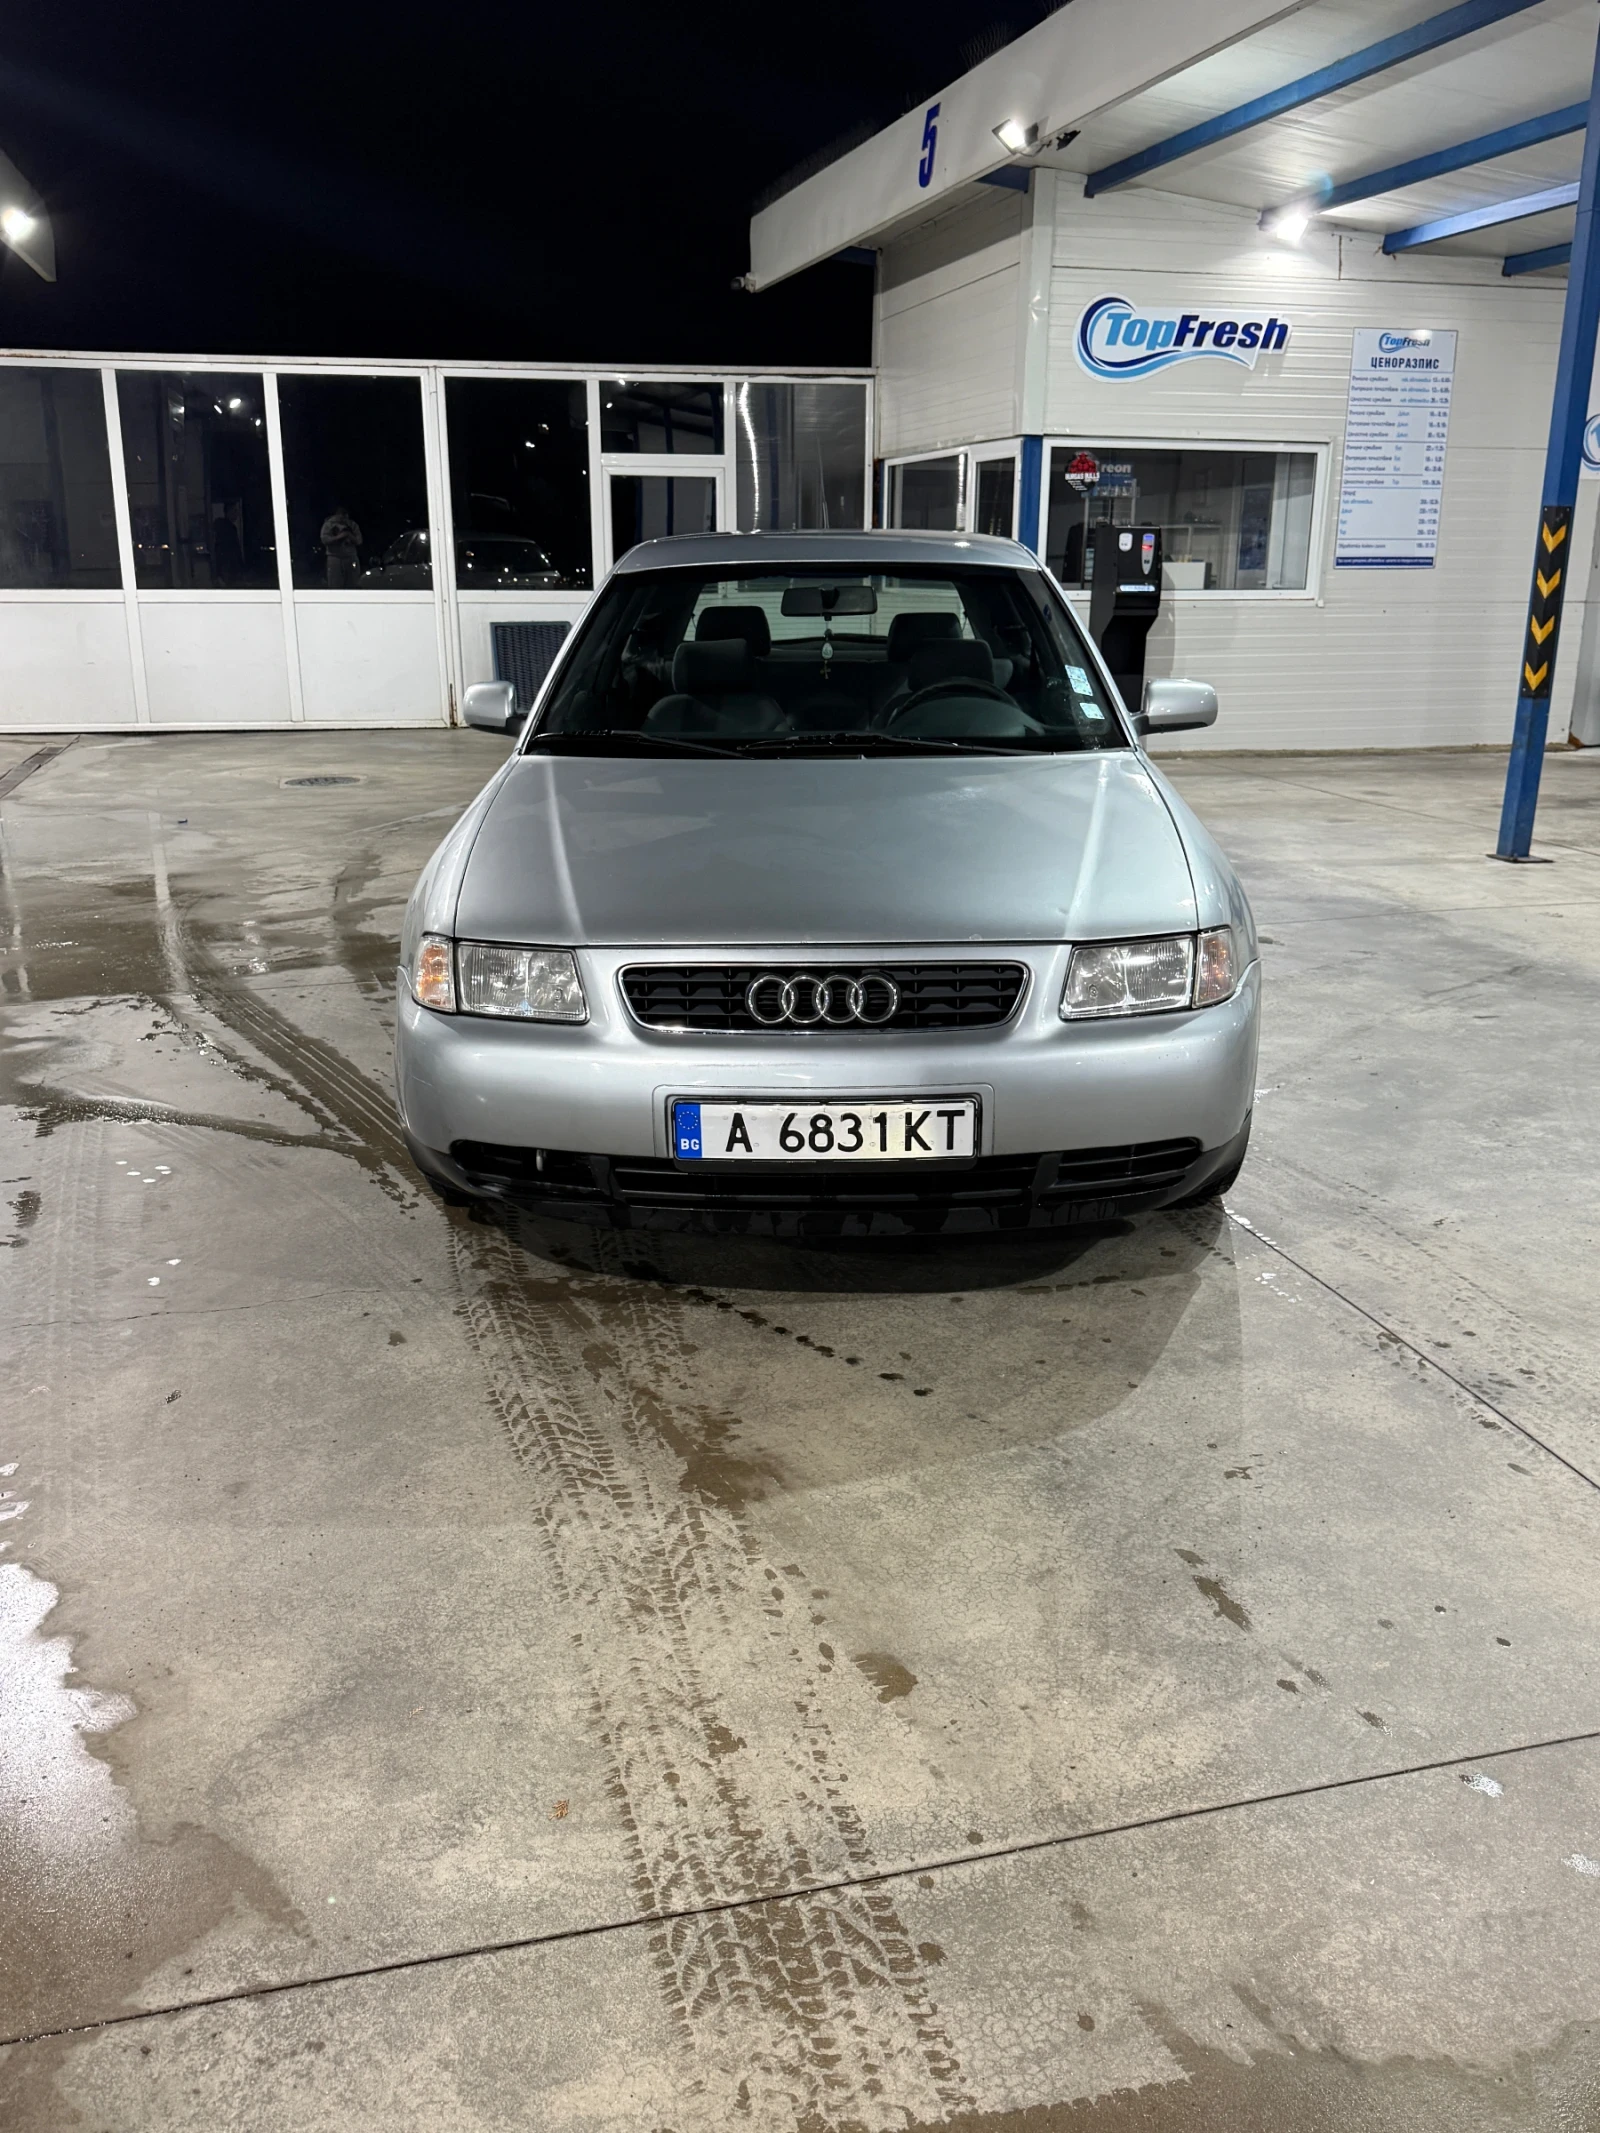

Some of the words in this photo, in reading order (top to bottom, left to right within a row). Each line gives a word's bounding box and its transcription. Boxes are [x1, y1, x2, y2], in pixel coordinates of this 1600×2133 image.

[919, 103, 941, 188] 5
[1104, 312, 1289, 351] TopFresh
[1371, 356, 1440, 369] ЦЕНОРАЗПИС
[1101, 464, 1132, 473] reon
[681, 1139, 700, 1151] BG
[725, 1112, 753, 1153] A
